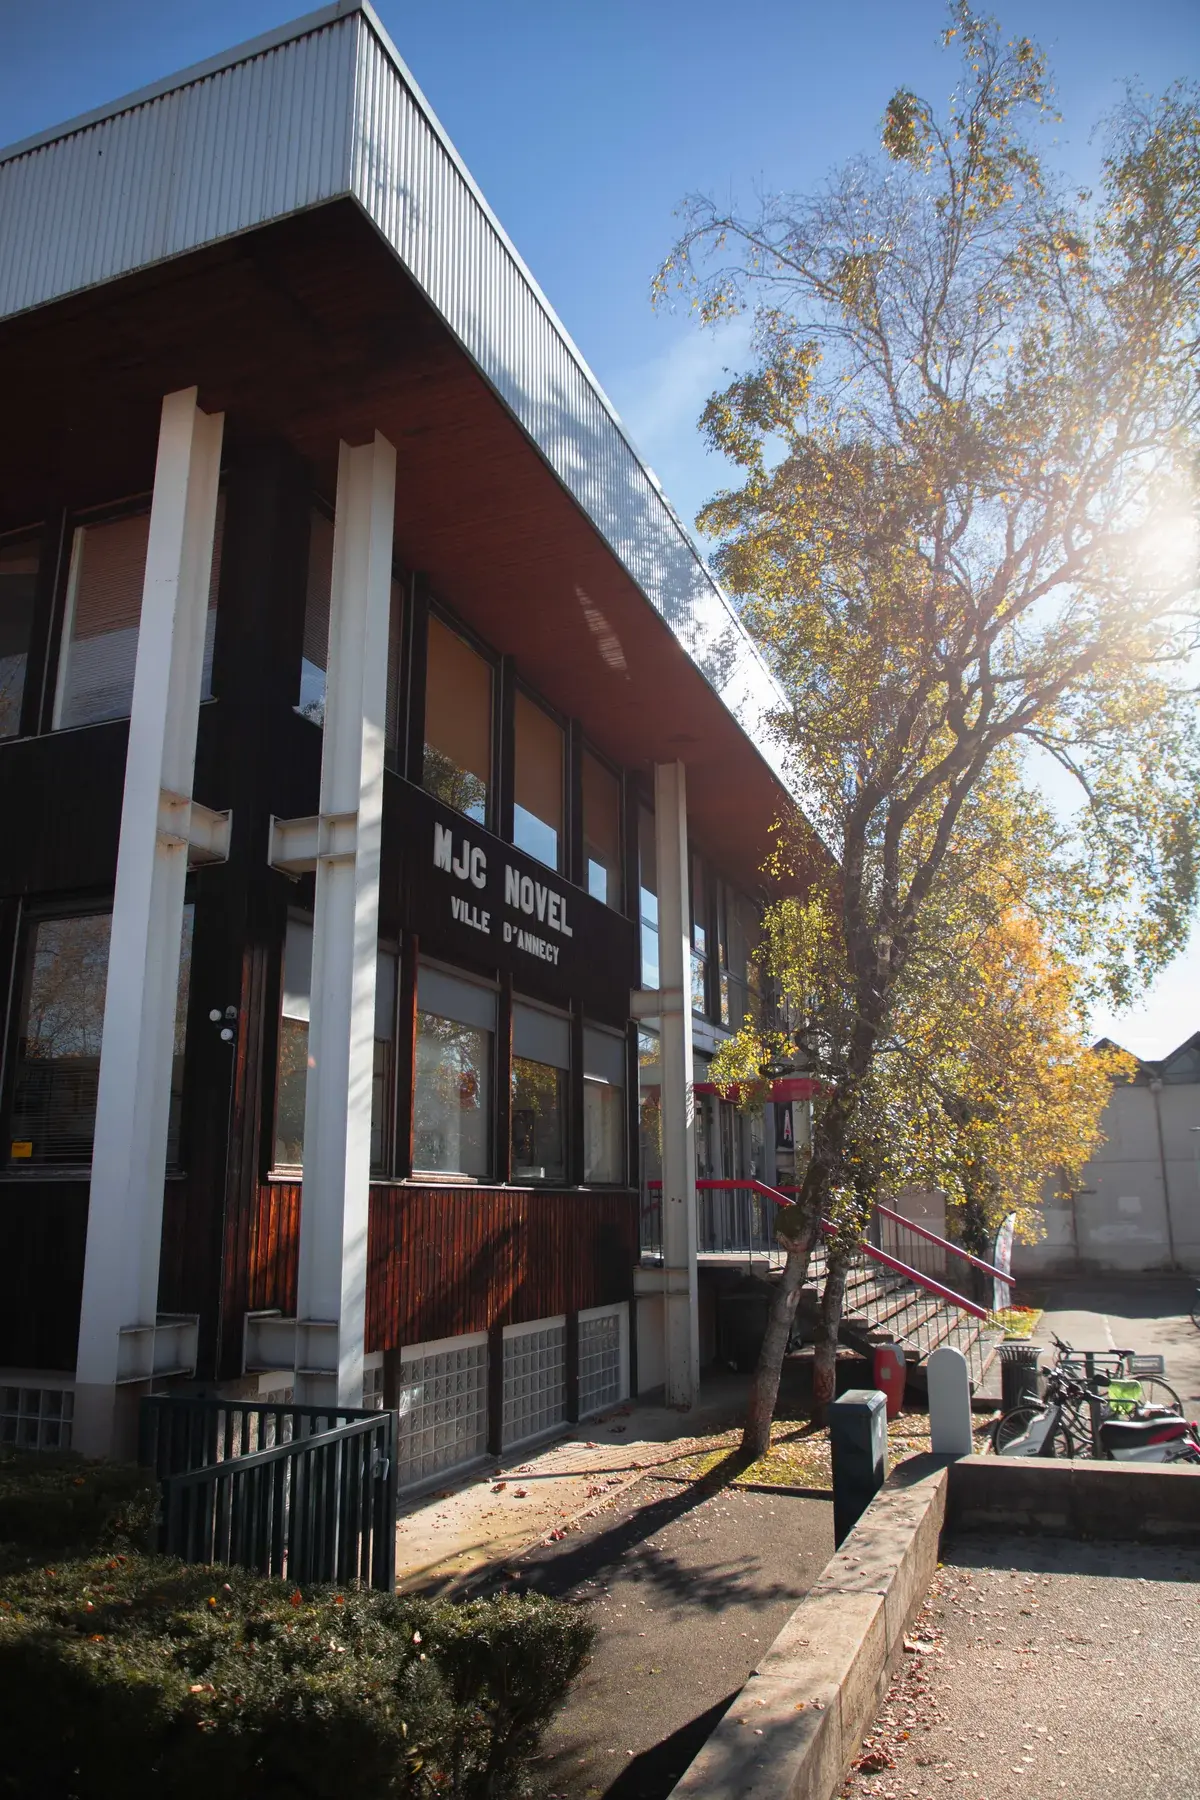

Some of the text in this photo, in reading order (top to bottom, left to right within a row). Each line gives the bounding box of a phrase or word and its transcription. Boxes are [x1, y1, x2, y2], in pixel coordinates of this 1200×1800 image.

[433, 822, 573, 938] MJC NOVEL
[450, 895, 560, 966] VILLE D'ANNECY
